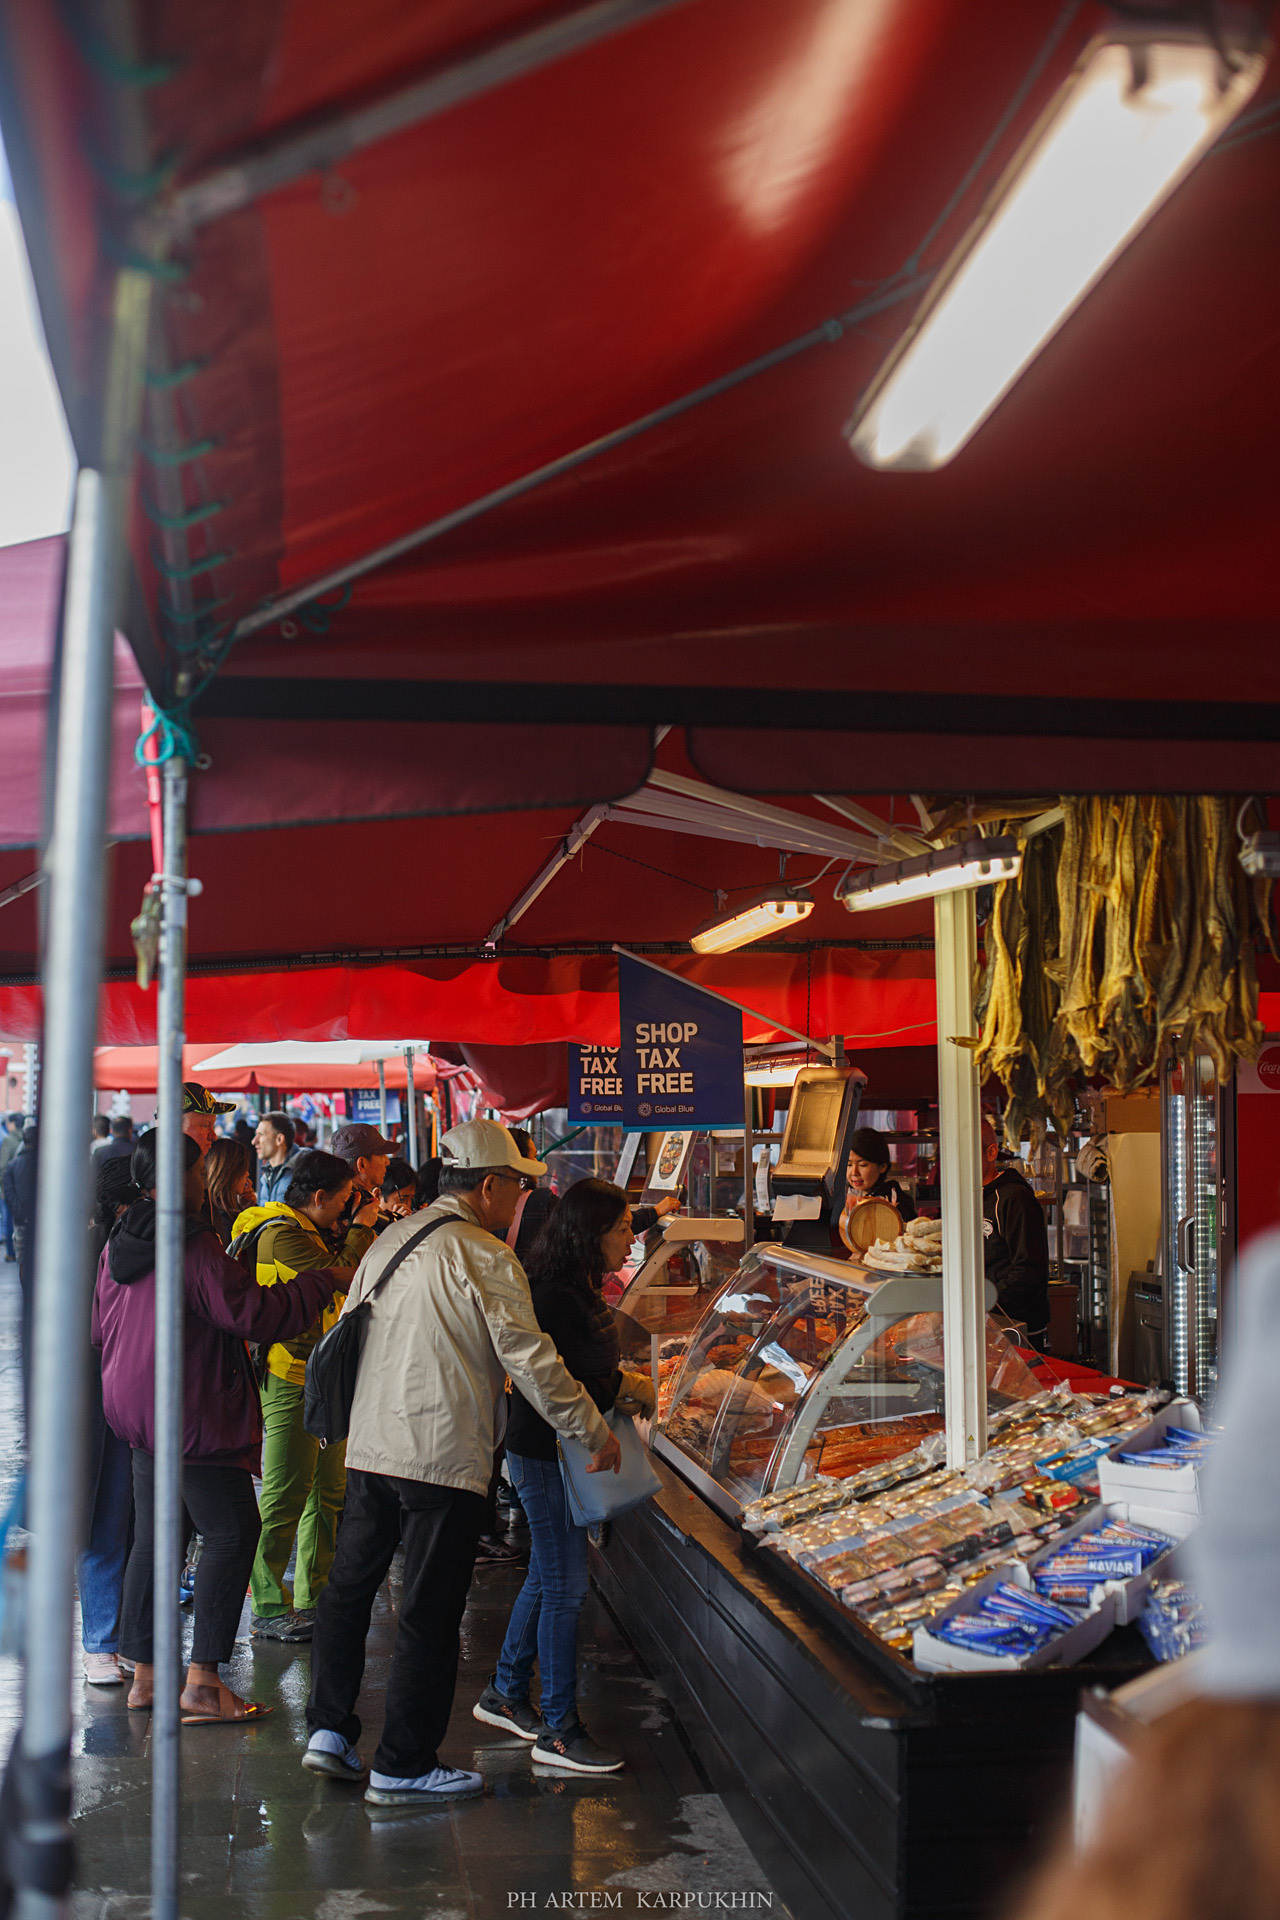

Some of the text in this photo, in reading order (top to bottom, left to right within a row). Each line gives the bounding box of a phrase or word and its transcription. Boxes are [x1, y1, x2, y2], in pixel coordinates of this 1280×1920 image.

[636, 1022, 698, 1043] SHOP
[580, 1057, 618, 1074] TAX
[636, 1048, 681, 1068] TAX
[637, 1073, 693, 1093] FREE
[358, 1091, 376, 1099] TAX
[594, 1104, 613, 1112] Global
[654, 1104, 695, 1114] Global Blue
[1089, 1559, 1134, 1575] KAVIAR
